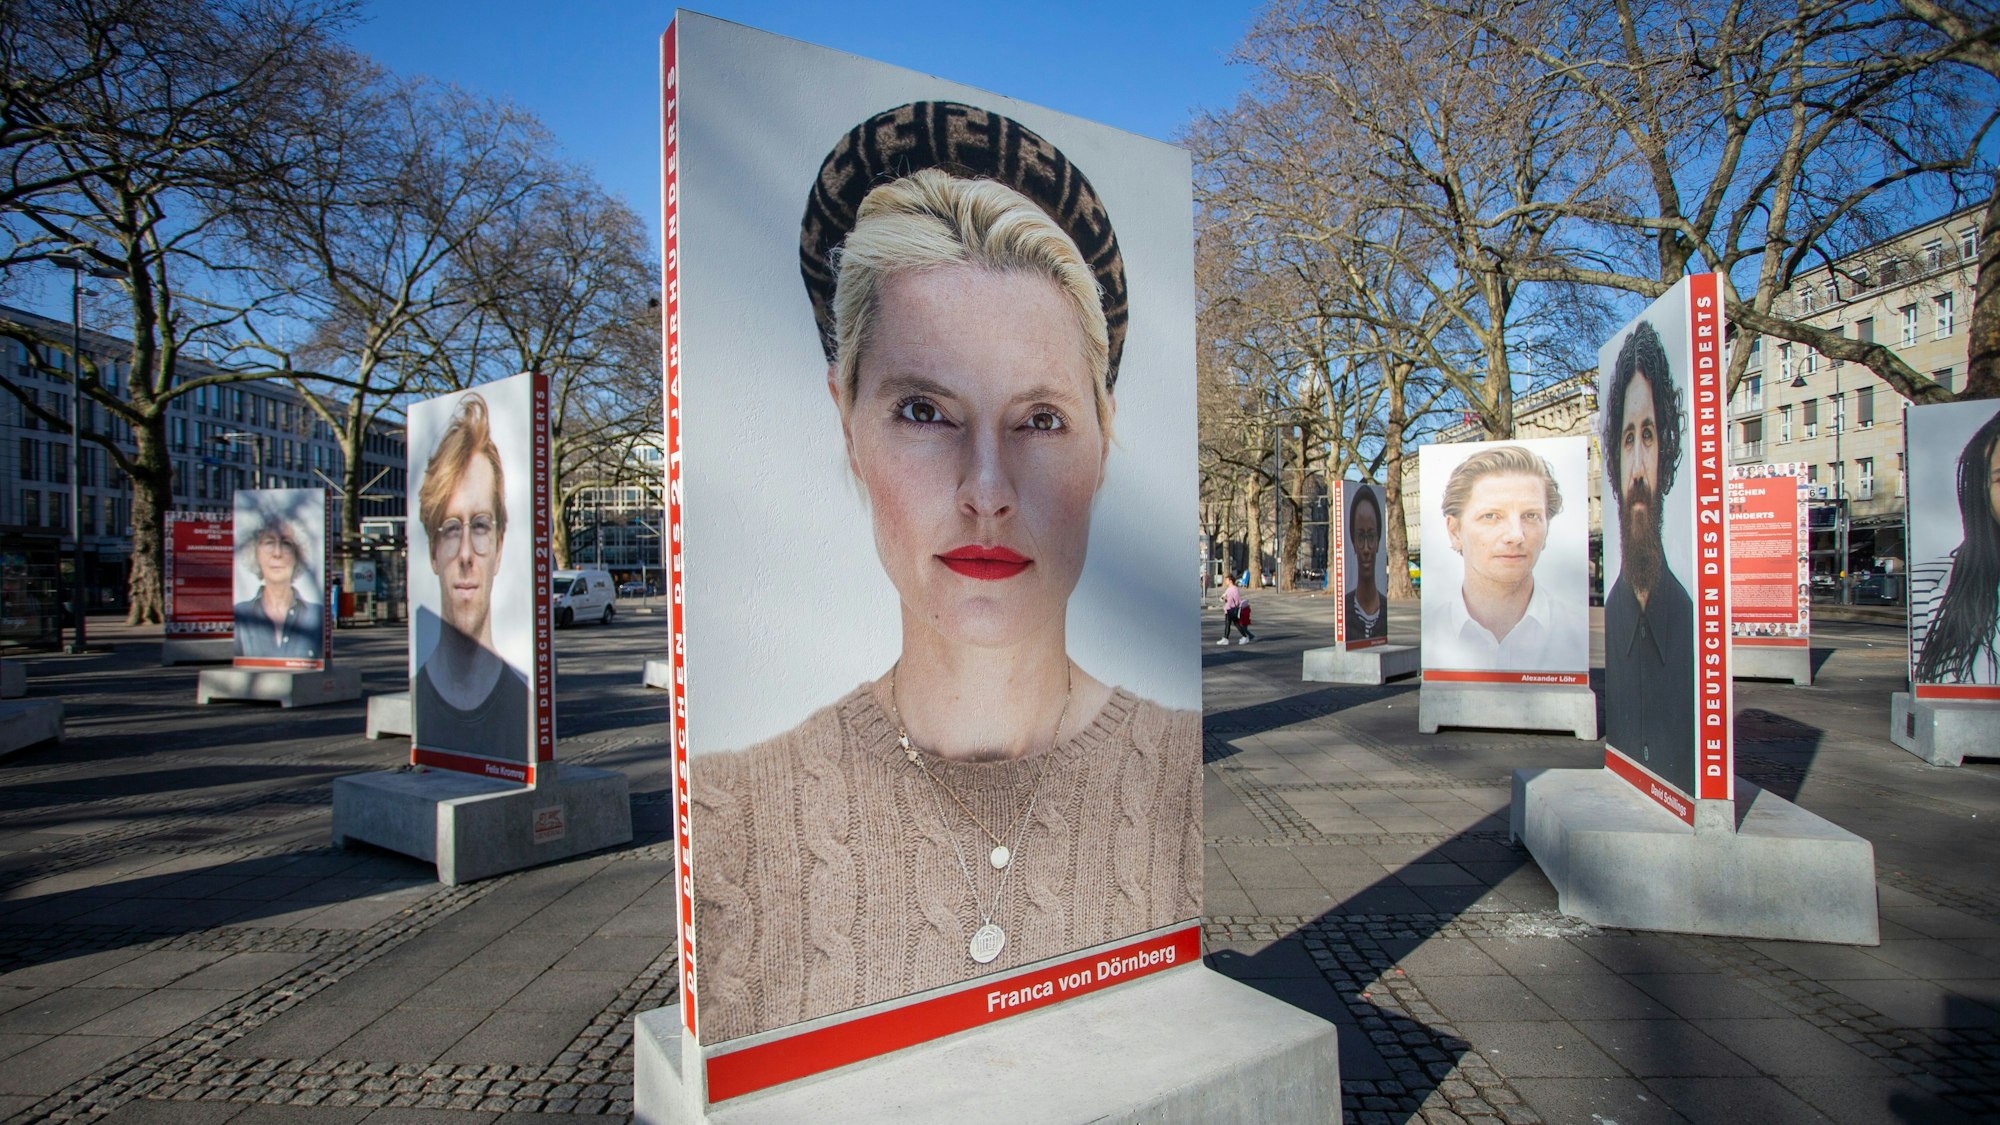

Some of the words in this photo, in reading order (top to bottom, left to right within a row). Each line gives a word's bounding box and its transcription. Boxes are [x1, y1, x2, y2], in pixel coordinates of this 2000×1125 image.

[667, 65, 679, 420] JAHRHUNDERTS
[1697, 295, 1717, 481] JAHRHUNDERTS
[535, 390, 546, 526] JAHRHUNDERTS
[670, 435, 681, 506] 21.
[1699, 487, 1720, 526] 21.
[535, 531, 549, 558] 21.
[672, 521, 682, 605] DES
[1703, 530, 1720, 575] DES
[537, 564, 547, 596] DES
[538, 604, 549, 708] DEUTSCHEN
[1521, 674, 1558, 683] Alexander
[1559, 675, 1577, 683] Löhr
[1704, 588, 1721, 727] DEUTSCHEN
[540, 715, 550, 745] DIE
[675, 632, 690, 898] DEUTSCHEN
[1707, 738, 1721, 777] DIE
[485, 763, 500, 774] Felix
[685, 921, 694, 995] DIE
[987, 981, 1053, 1013] Franca
[1058, 968, 1092, 992] von
[1096, 944, 1177, 981] Dörnberg
